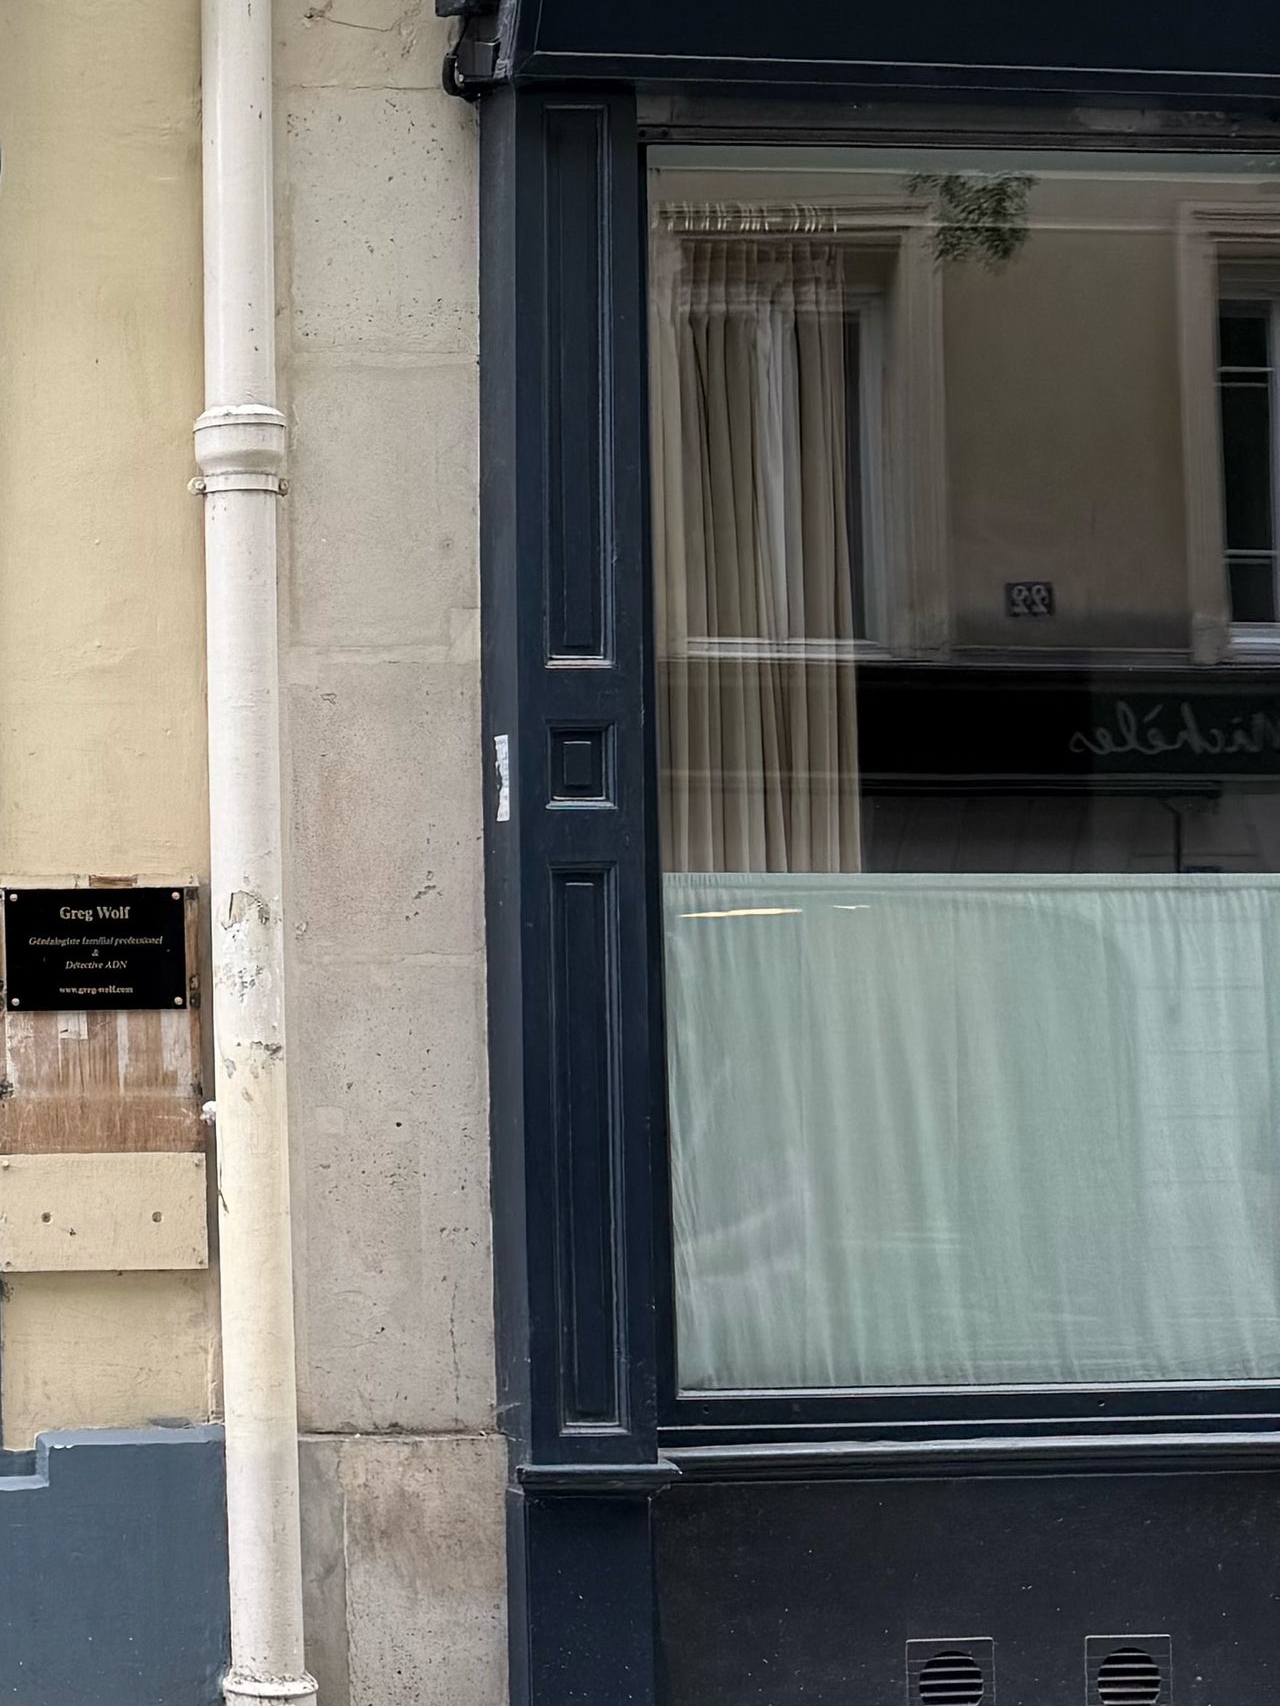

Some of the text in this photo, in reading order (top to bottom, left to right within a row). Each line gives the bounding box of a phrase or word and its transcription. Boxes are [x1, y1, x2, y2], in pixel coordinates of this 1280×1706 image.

[59, 905, 131, 922] Greg Wolf
[91, 948, 100, 957] &
[104, 960, 128, 970] ADN
